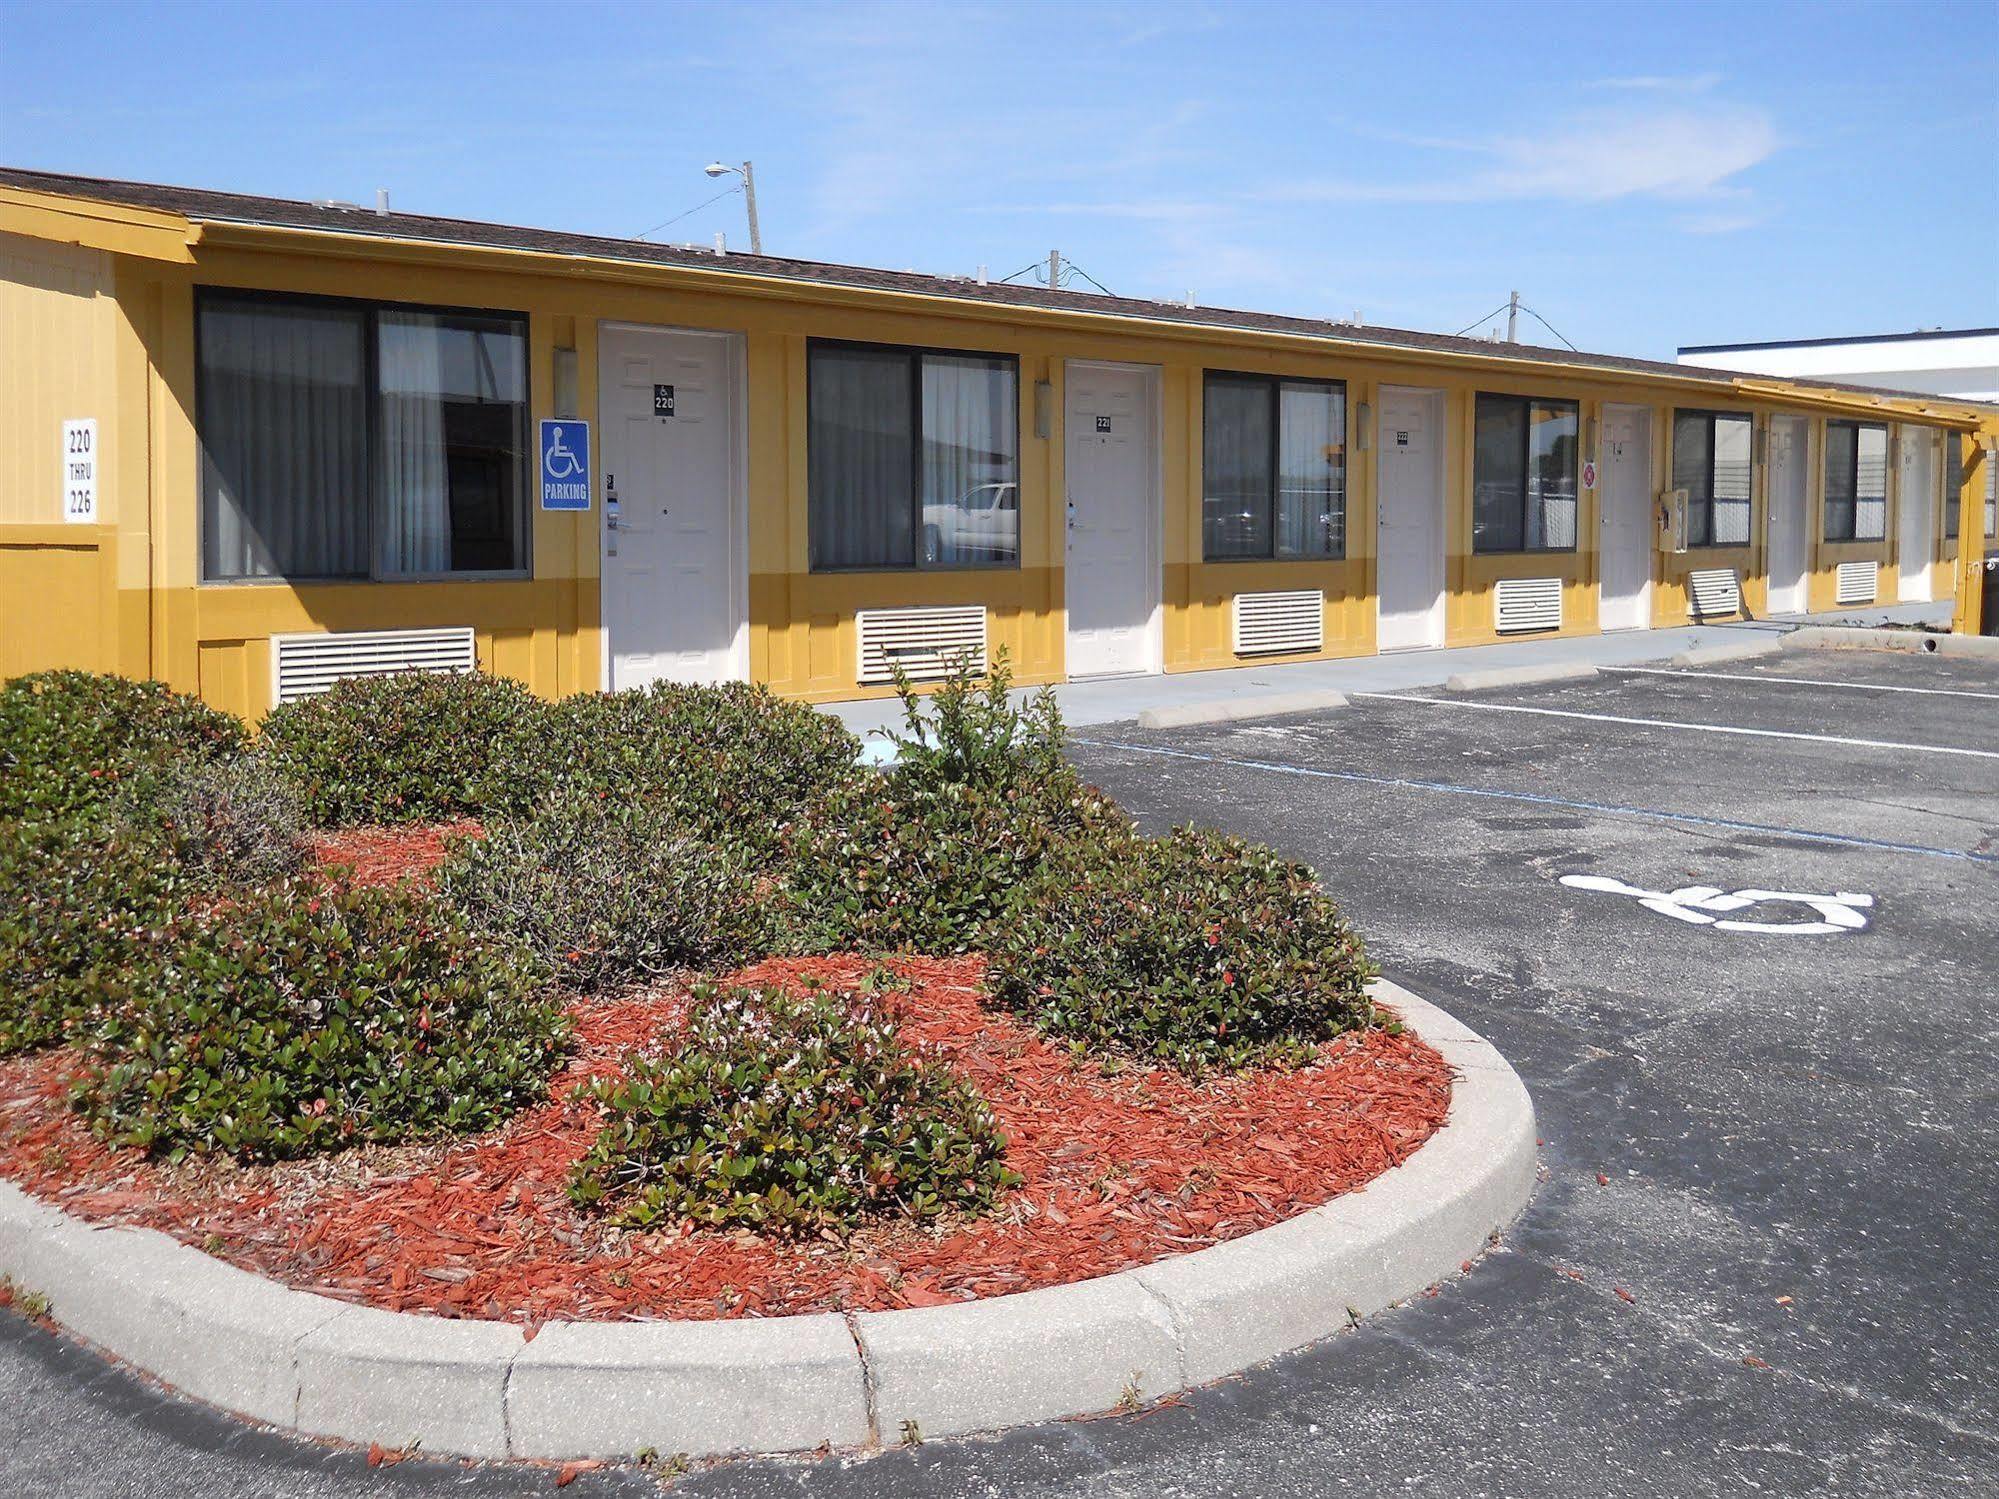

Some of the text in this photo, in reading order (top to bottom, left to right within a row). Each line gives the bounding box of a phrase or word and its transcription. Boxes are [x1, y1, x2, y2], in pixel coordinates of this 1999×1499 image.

[655, 397, 674, 409] 220
[70, 428, 91, 453] 220
[69, 462, 92, 481] THRU
[70, 489, 91, 513] 226
[544, 483, 587, 500] PARKING
